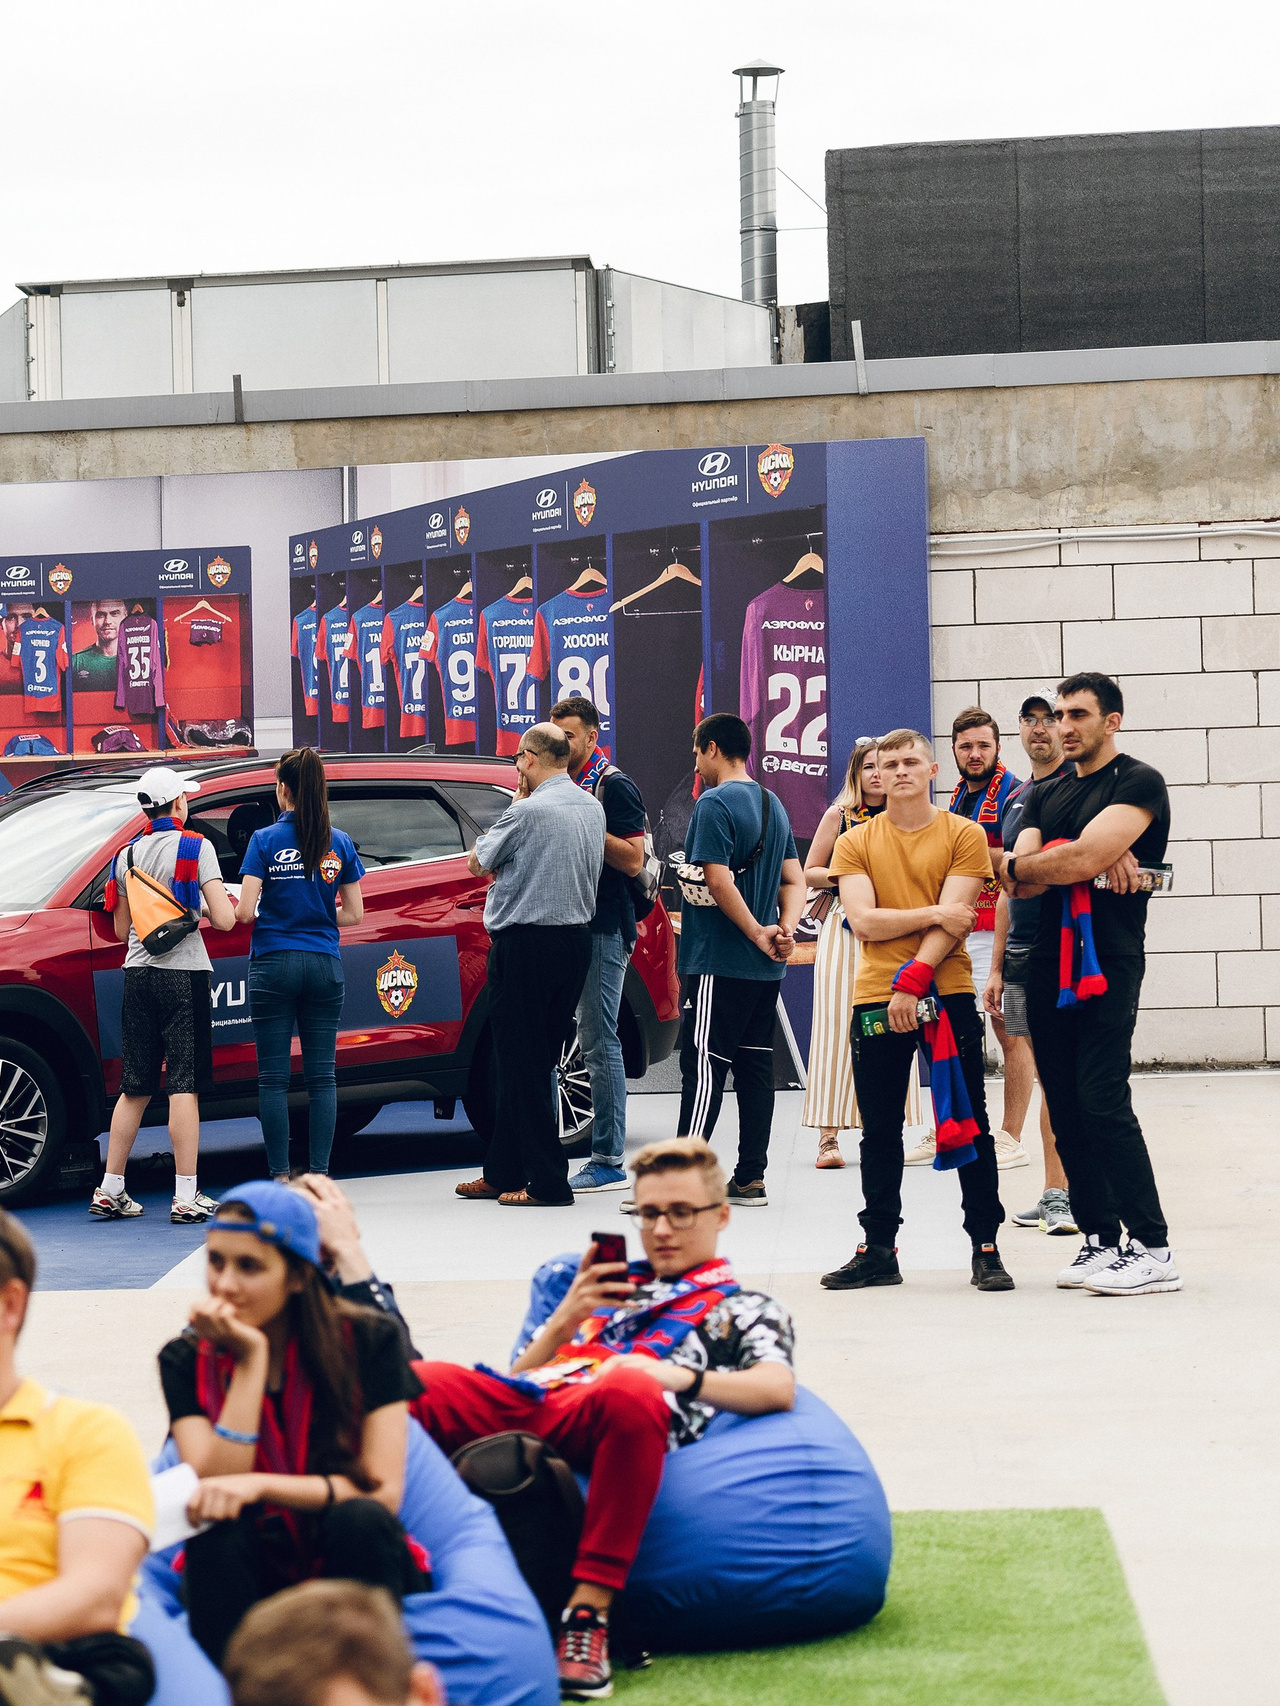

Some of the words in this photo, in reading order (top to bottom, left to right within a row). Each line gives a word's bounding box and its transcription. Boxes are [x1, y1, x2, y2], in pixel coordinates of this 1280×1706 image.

[760, 453, 792, 474] ЦСКА
[691, 474, 738, 493] HYUNDAI
[532, 507, 562, 521] HYUNDAI
[425, 529, 447, 540] HYUNDAI
[0, 580, 36, 588] HYUNDAI
[158, 573, 194, 581] HYUNDAI
[452, 632, 474, 646] ОБЛ
[128, 646, 151, 680] 35
[773, 644, 826, 664] КЫРНА
[35, 651, 47, 683] 3
[365, 648, 385, 692] 1
[404, 652, 426, 700] 7
[448, 650, 476, 702] 9
[765, 672, 828, 758] 22
[321, 859, 340, 870] ЦСКА
[379, 970, 416, 991] ЦСКА
